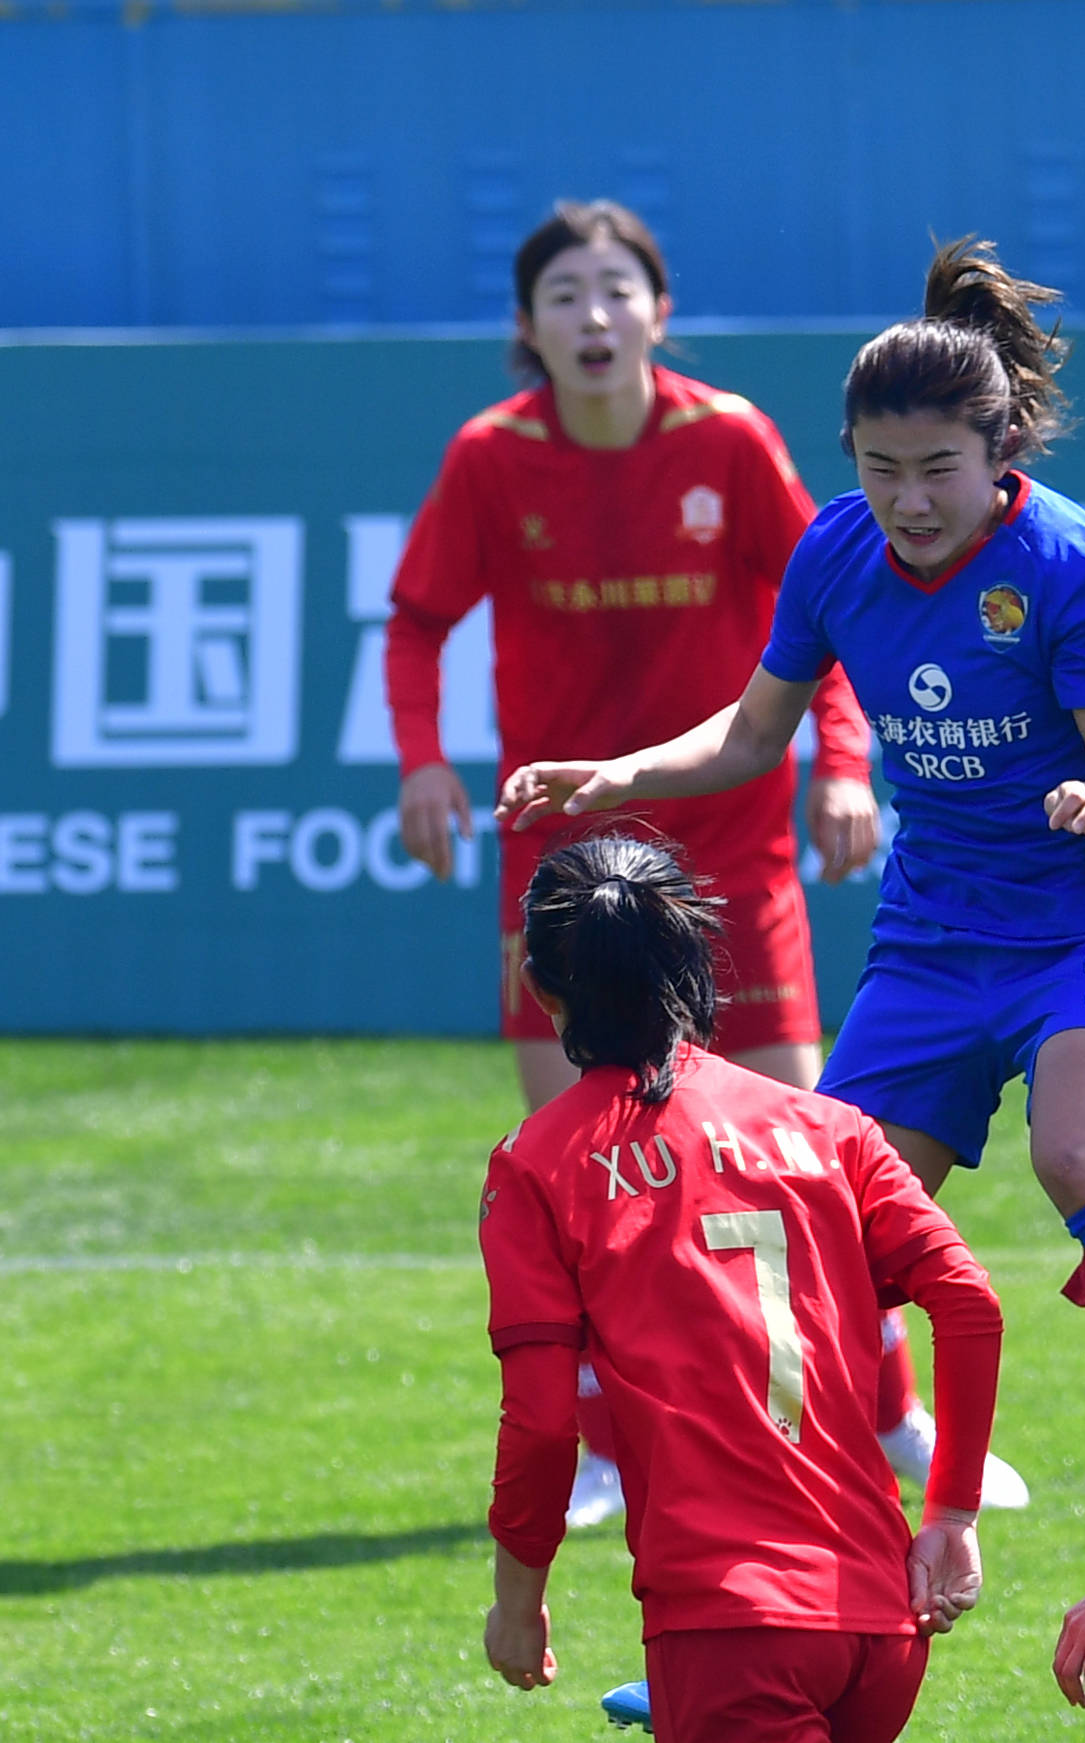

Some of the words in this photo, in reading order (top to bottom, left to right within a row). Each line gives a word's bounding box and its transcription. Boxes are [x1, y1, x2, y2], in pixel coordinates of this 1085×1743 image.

[905, 751, 985, 780] SRCB
[590, 1134, 677, 1200] XU
[700, 1210, 804, 1444] 7
